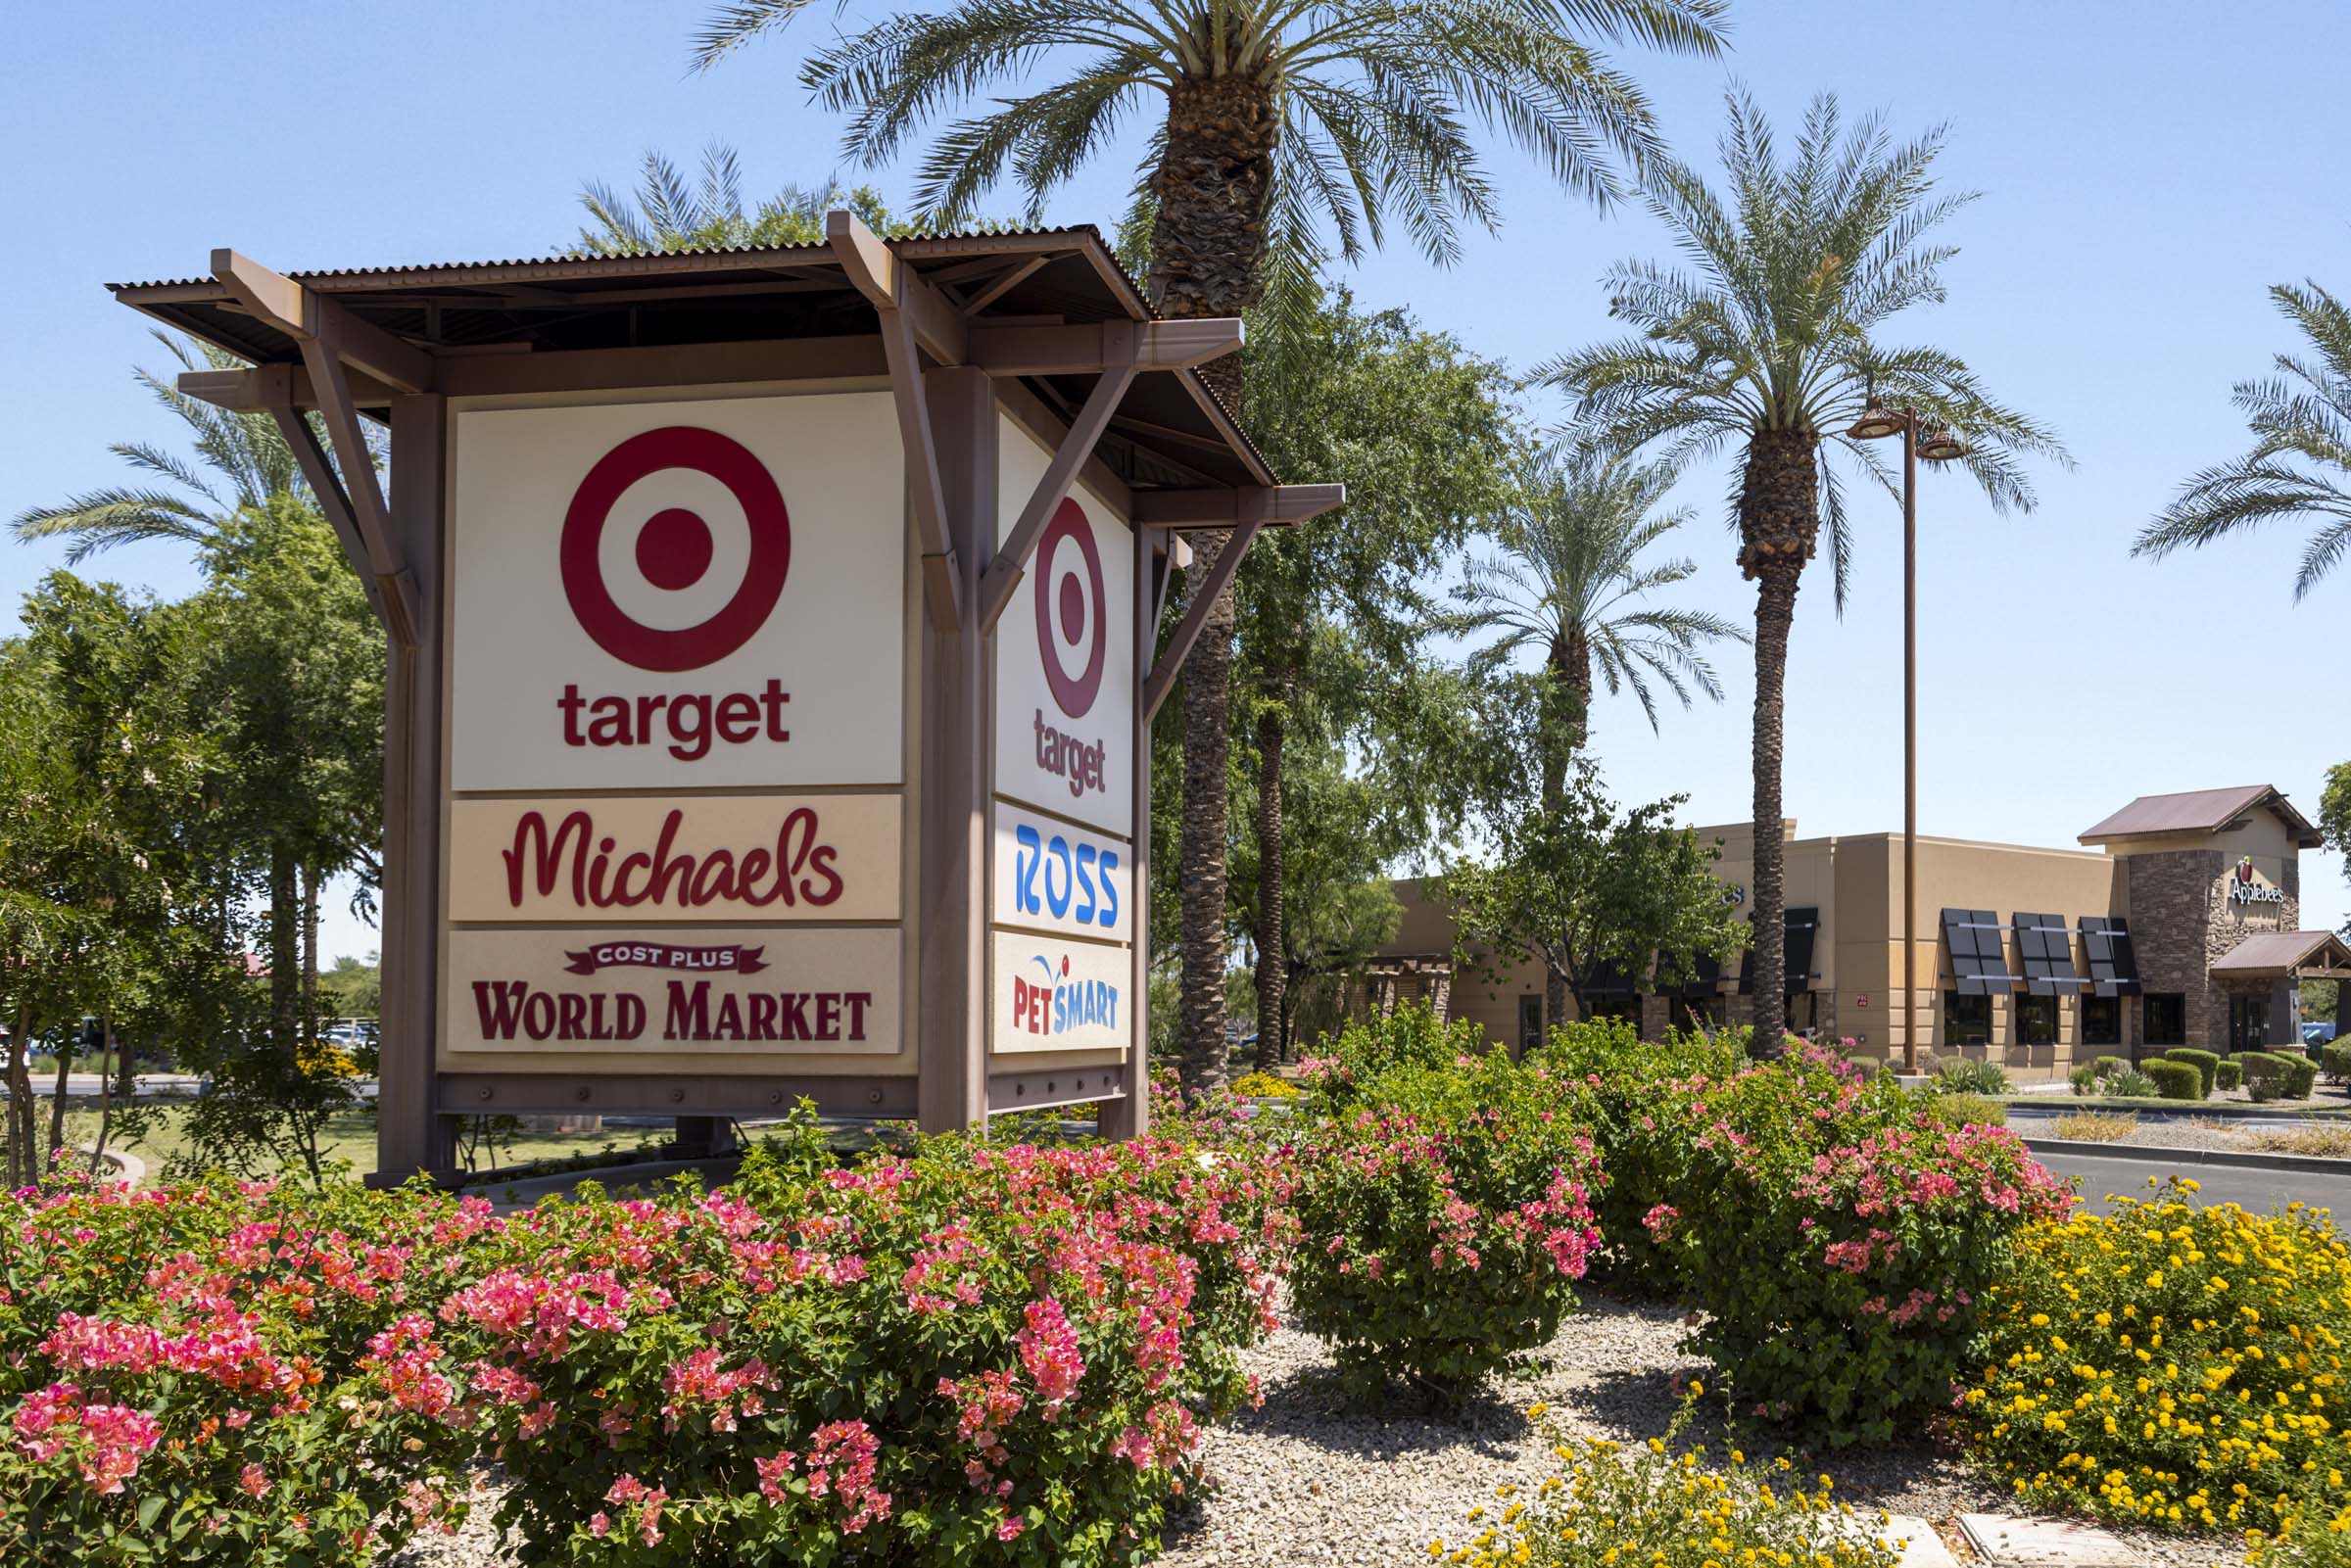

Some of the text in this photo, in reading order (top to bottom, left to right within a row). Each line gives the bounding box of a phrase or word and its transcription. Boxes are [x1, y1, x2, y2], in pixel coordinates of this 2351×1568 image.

[557, 679, 791, 762] target
[1033, 708, 1106, 798] target
[502, 807, 844, 908] Michaels
[1016, 824, 1119, 927] ROSS
[597, 946, 735, 968] COST PLUS
[471, 980, 873, 1042] WORLD MARKET
